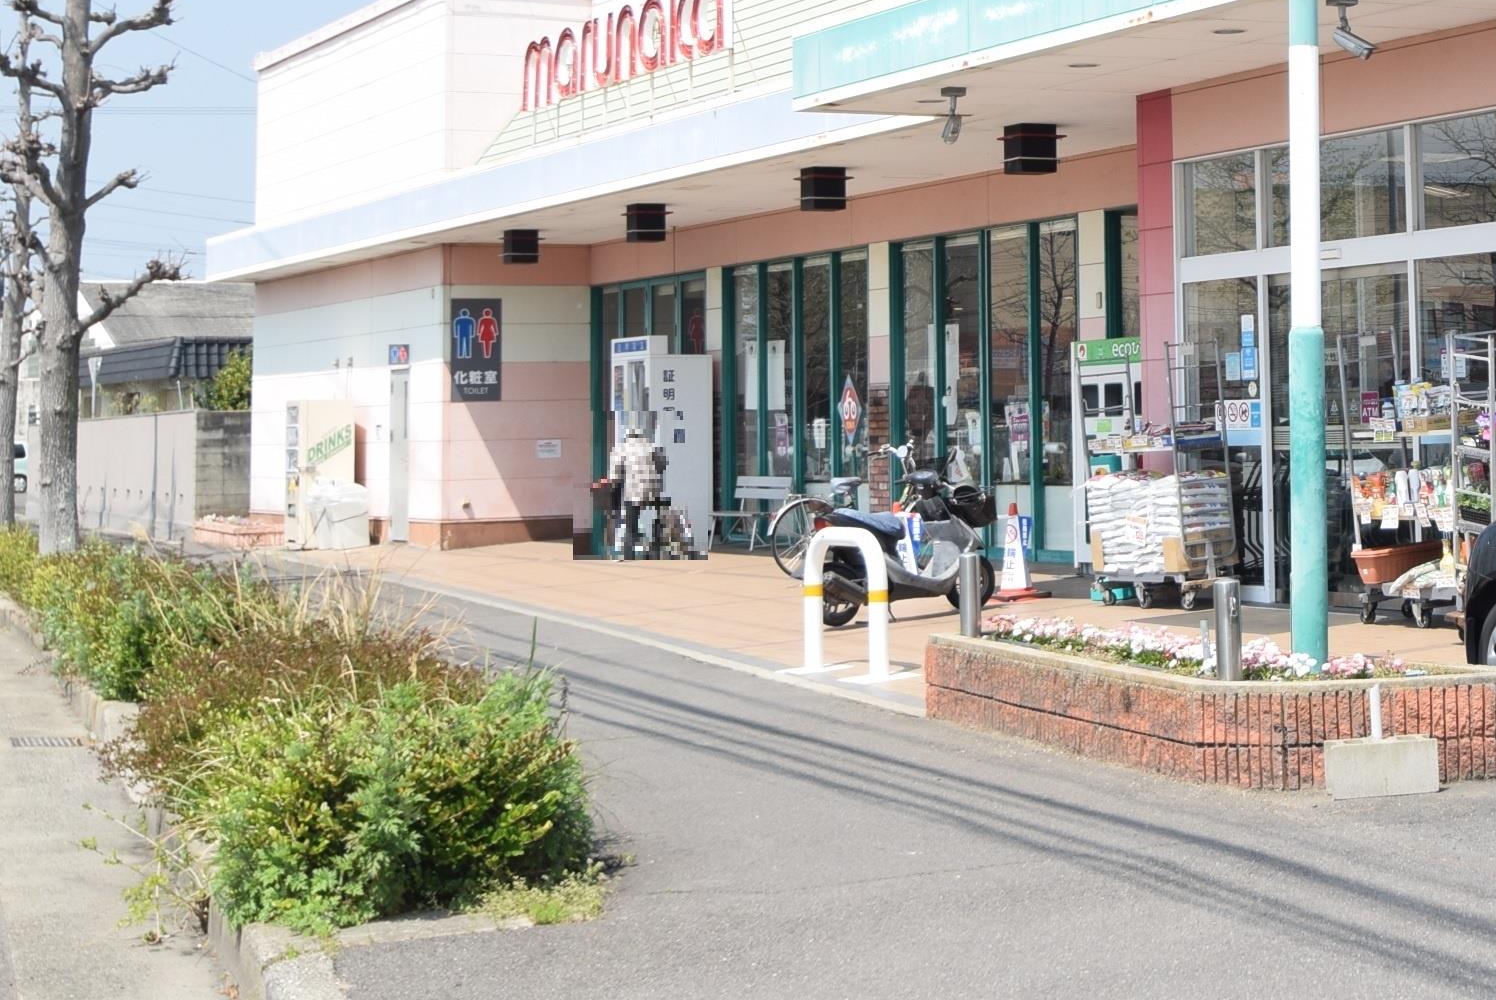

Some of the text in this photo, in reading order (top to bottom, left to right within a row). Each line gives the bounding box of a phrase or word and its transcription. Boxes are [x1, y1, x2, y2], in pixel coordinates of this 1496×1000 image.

[454, 370, 498, 385] 化粧室
[463, 386, 489, 395] TOILET
[663, 369, 675, 411] 証明
[1362, 407, 1379, 417] ATM
[307, 424, 352, 463] DRINKS
